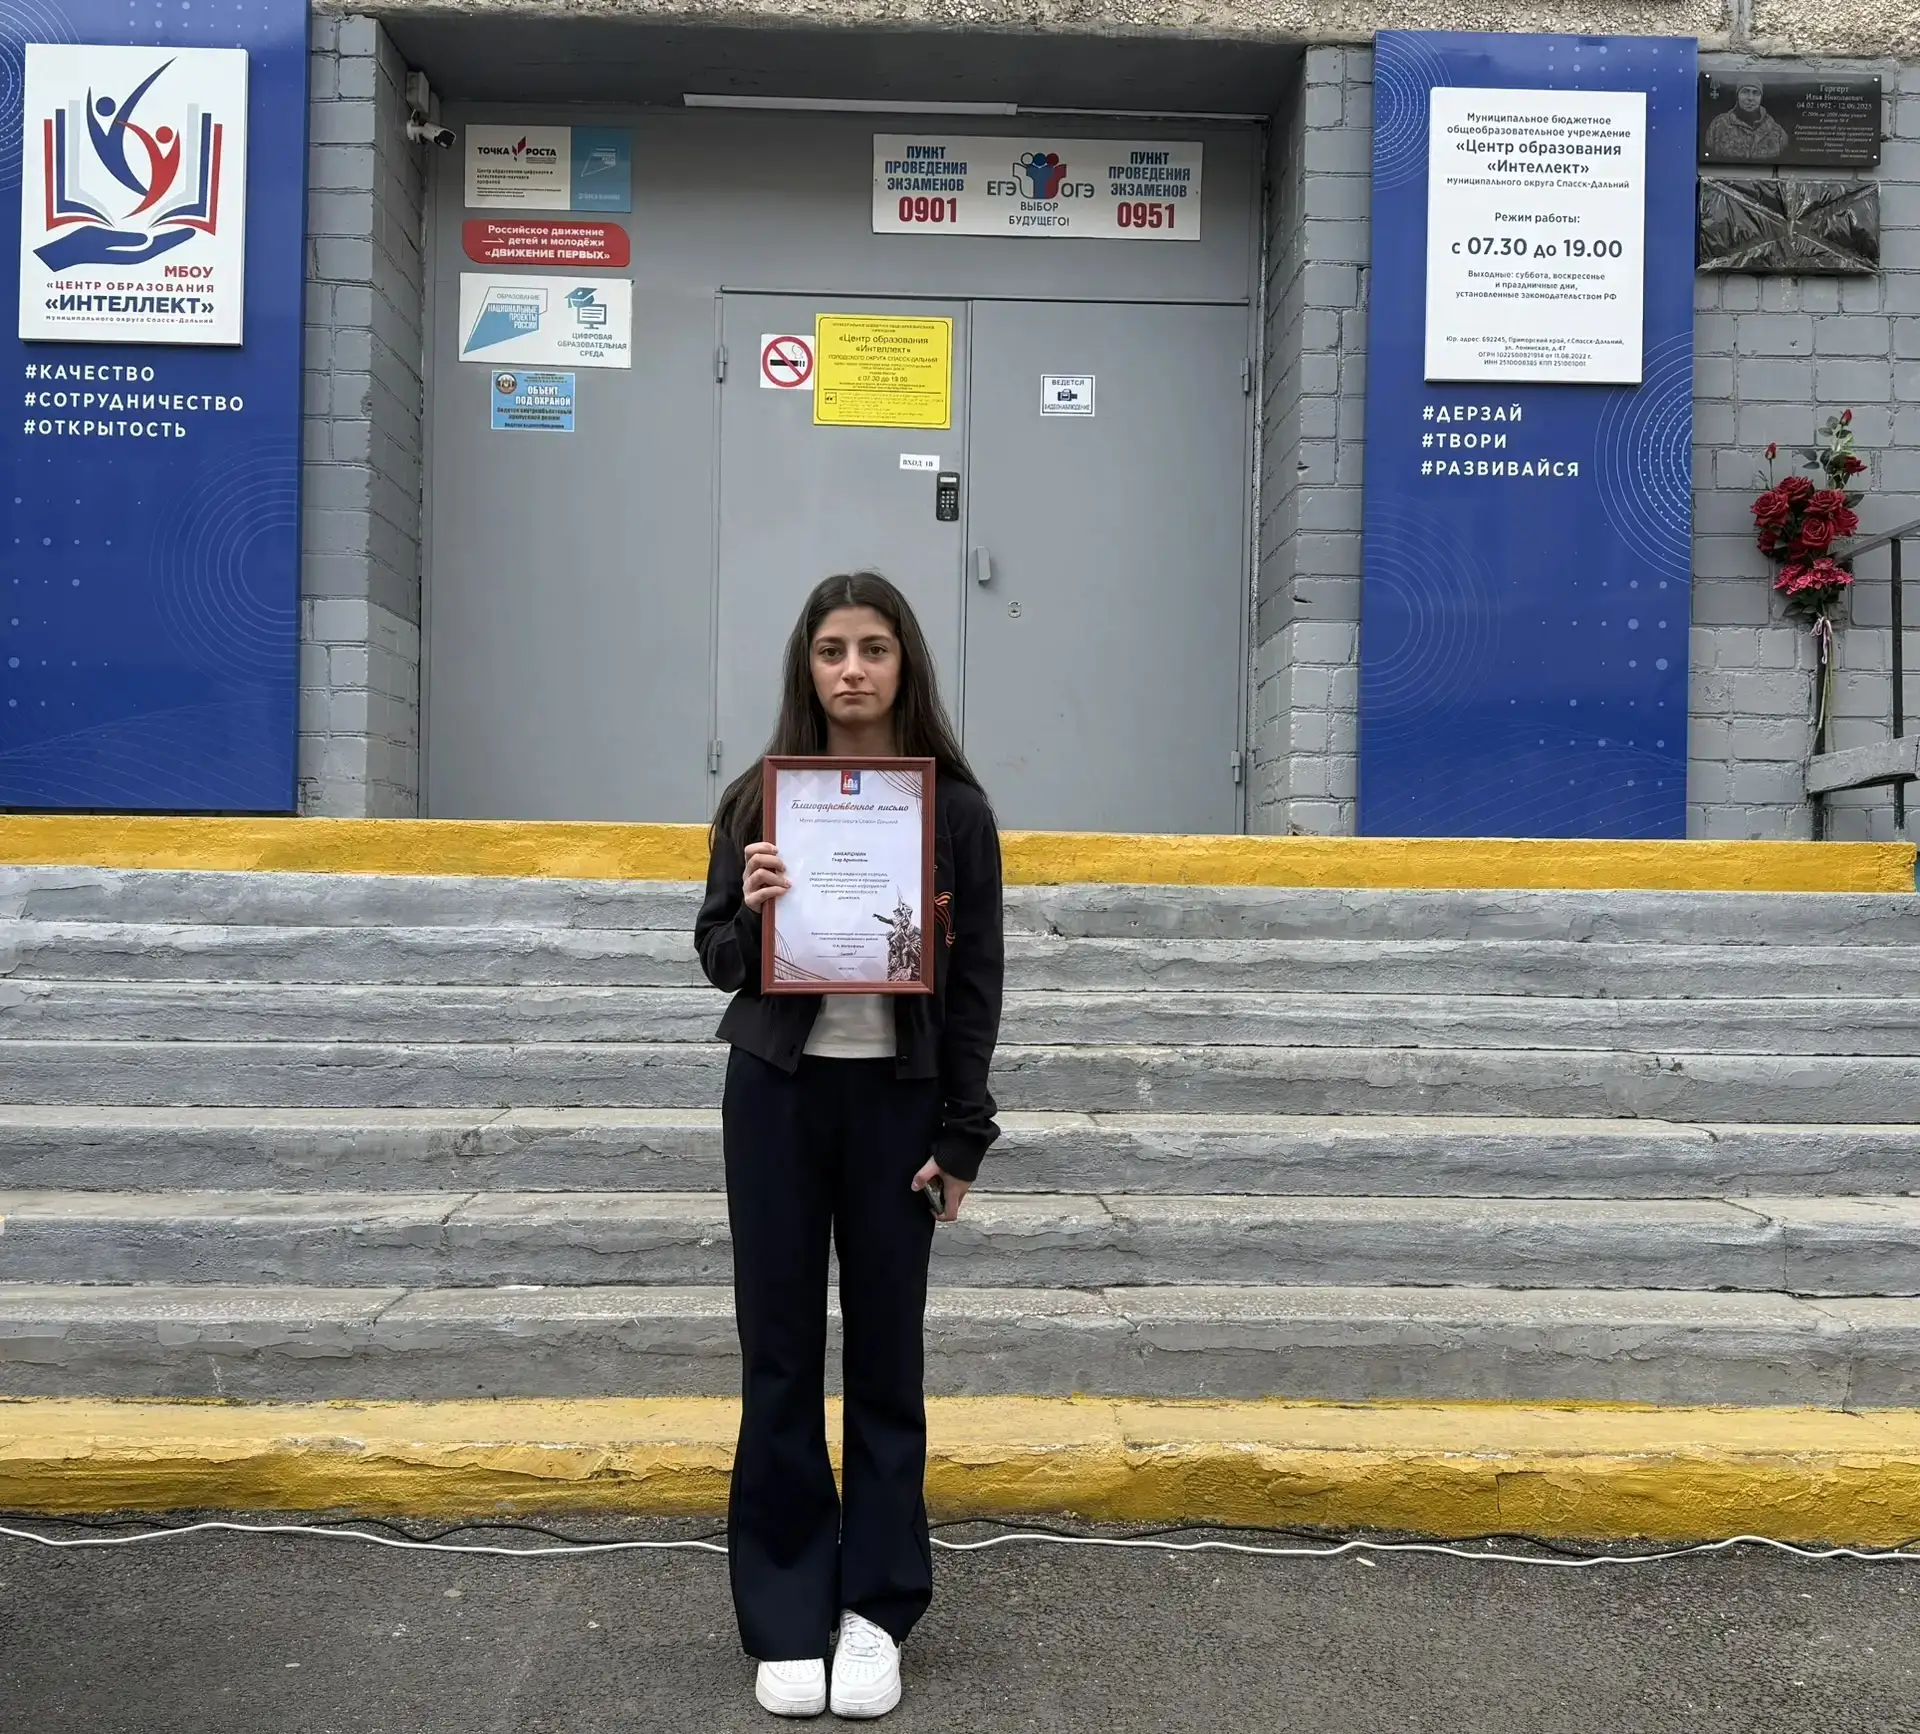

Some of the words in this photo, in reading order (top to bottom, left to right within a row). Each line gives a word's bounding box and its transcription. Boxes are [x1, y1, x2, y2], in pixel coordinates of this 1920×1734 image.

[1467, 113, 1549, 124] Муниципальное
[1552, 115, 1611, 125] бюджетное
[1447, 126, 1564, 137] общеобразовательное
[1568, 128, 1630, 138] учреждение
[477, 147, 509, 155] ТОЧКА
[526, 148, 556, 156] РОСТА
[907, 146, 946, 159] ПУНКТ
[1456, 139, 1514, 155] «Центр
[1518, 141, 1621, 156] образования
[1130, 152, 1169, 164] ПУНКТ
[885, 161, 967, 176] ПРОВЕДЕНИЯ
[1488, 160, 1589, 174] «Интеллект»
[1108, 167, 1190, 182] ПРОВЕДЕНИЯ
[888, 178, 964, 191] ЭКЗАМЕНОВ
[987, 180, 1016, 196] ЕГЭ
[1447, 177, 1521, 187] муниципального
[1524, 180, 1554, 188] округа
[1556, 179, 1630, 189] Спасск-Дальний
[1061, 183, 1094, 198] ОГЭ
[1111, 183, 1187, 198] ЭКЗАМЕНОВ
[899, 196, 957, 223] 0901
[1020, 202, 1058, 212] ВЫБОР
[1009, 216, 1070, 226] БУДУЩЕГО!
[1117, 202, 1175, 228] 0951
[1495, 212, 1532, 222] Режим
[1535, 213, 1580, 224] работы:
[488, 225, 548, 235] Российское
[508, 237, 538, 245] детей
[550, 238, 604, 247] молодёжи
[1452, 242, 1460, 254] с
[1467, 237, 1527, 256] 07.30
[1533, 244, 1556, 258] до
[1563, 239, 1622, 258] 19.00
[485, 248, 554, 258] «ДВИЖЕНИЕ
[557, 250, 610, 259] ПЕРВЫХ»
[164, 266, 213, 278] МБОУ
[1516, 271, 1551, 280] суббота,
[47, 281, 101, 290] «ЦЕНТР
[107, 282, 214, 293] ОБРАЗОВАНИЯ
[1456, 291, 1519, 300] установленные
[1604, 293, 1616, 301] РФ
[45, 294, 214, 314] «ИНТЕЛЛЕКТ»
[488, 305, 537, 313] НАЦИОНАЛЬНЫЕ
[509, 313, 537, 321] ПРОЕКТЫ
[557, 341, 627, 350] ОБРАЗОВАТЕЛЬНАЯ
[839, 334, 871, 344] «Центр
[873, 335, 928, 345] образования
[856, 344, 911, 354] «Интеллект»
[25, 364, 154, 381] #КАЧЕСТВО
[528, 385, 558, 395] ОБЪЕКТ
[24, 392, 244, 411] #СОТРУДНИЧЕСТВО
[516, 396, 532, 405] ПОД
[534, 396, 570, 406] ОХРАНОЙ
[1422, 403, 1522, 423] #ДЕРЗАЙ
[24, 420, 186, 438] #ОТКРЫТОСТЬ
[1422, 433, 1507, 448] #ТВОРИ
[1421, 458, 1579, 476] #РАЗВИВАЙСЯ
[791, 800, 874, 812] Благодарственное
